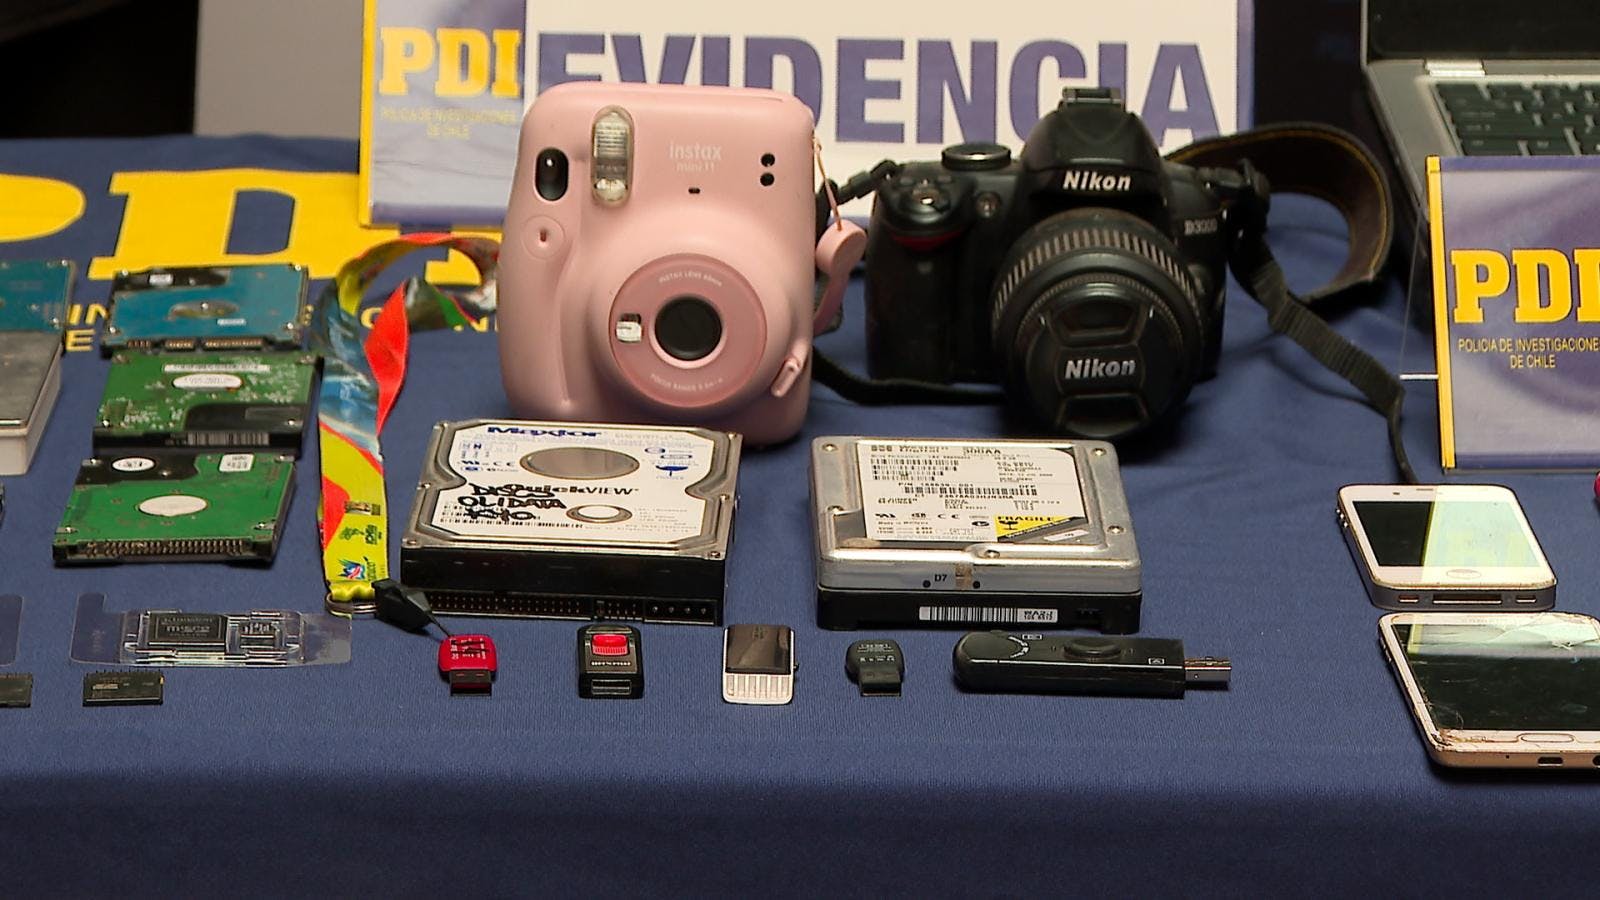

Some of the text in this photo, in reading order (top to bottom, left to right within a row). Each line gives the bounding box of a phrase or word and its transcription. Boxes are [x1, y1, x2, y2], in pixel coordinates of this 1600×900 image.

[379, 27, 520, 98] PDI
[668, 140, 722, 161] instax
[1062, 170, 1132, 191] Nikon
[1450, 248, 1600, 324] PDI
[1458, 337, 1600, 352] POLICIA DE INVESTIGACIONE
[1064, 358, 1137, 380] Nikon
[1510, 353, 1556, 369] DE CHILE
[487, 426, 599, 437] Maxtor
[934, 574, 948, 583] D7
